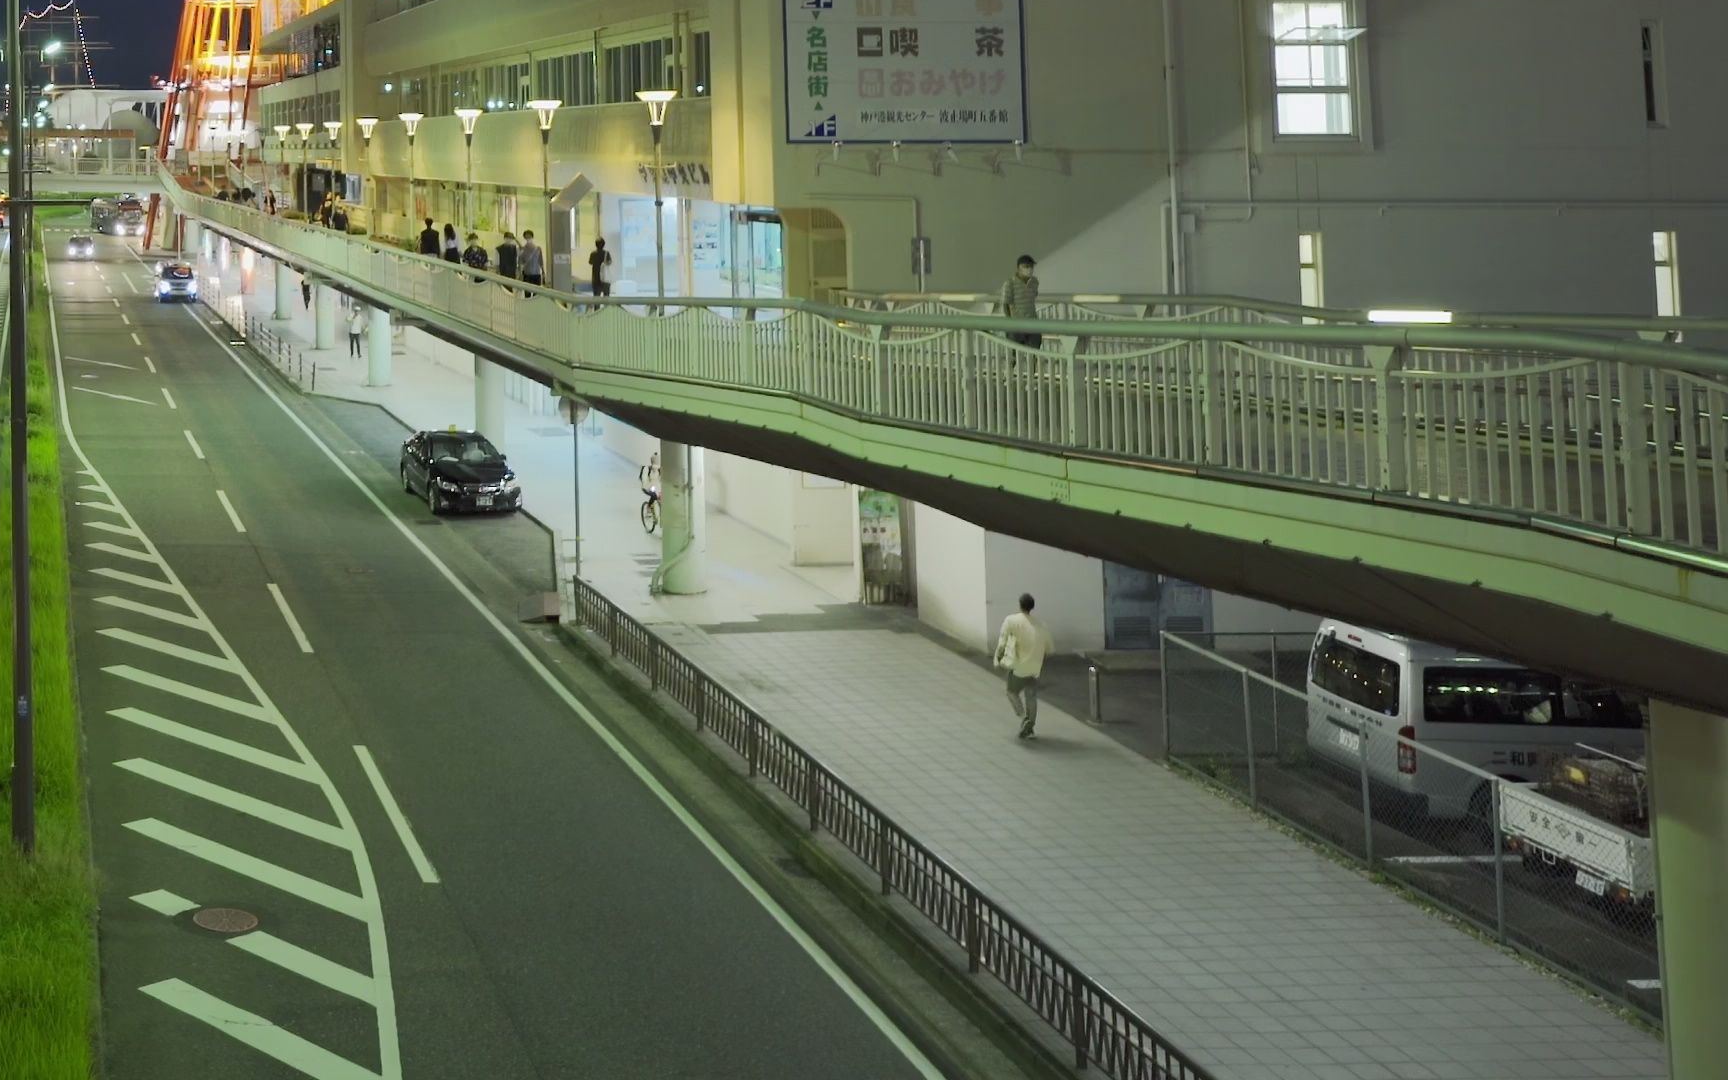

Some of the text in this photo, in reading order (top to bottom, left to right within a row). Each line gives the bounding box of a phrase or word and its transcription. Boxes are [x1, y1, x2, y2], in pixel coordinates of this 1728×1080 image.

[889, 27, 1005, 57] 喫茶
[806, 26, 829, 98] 名店街
[811, 121, 836, 137] 1F
